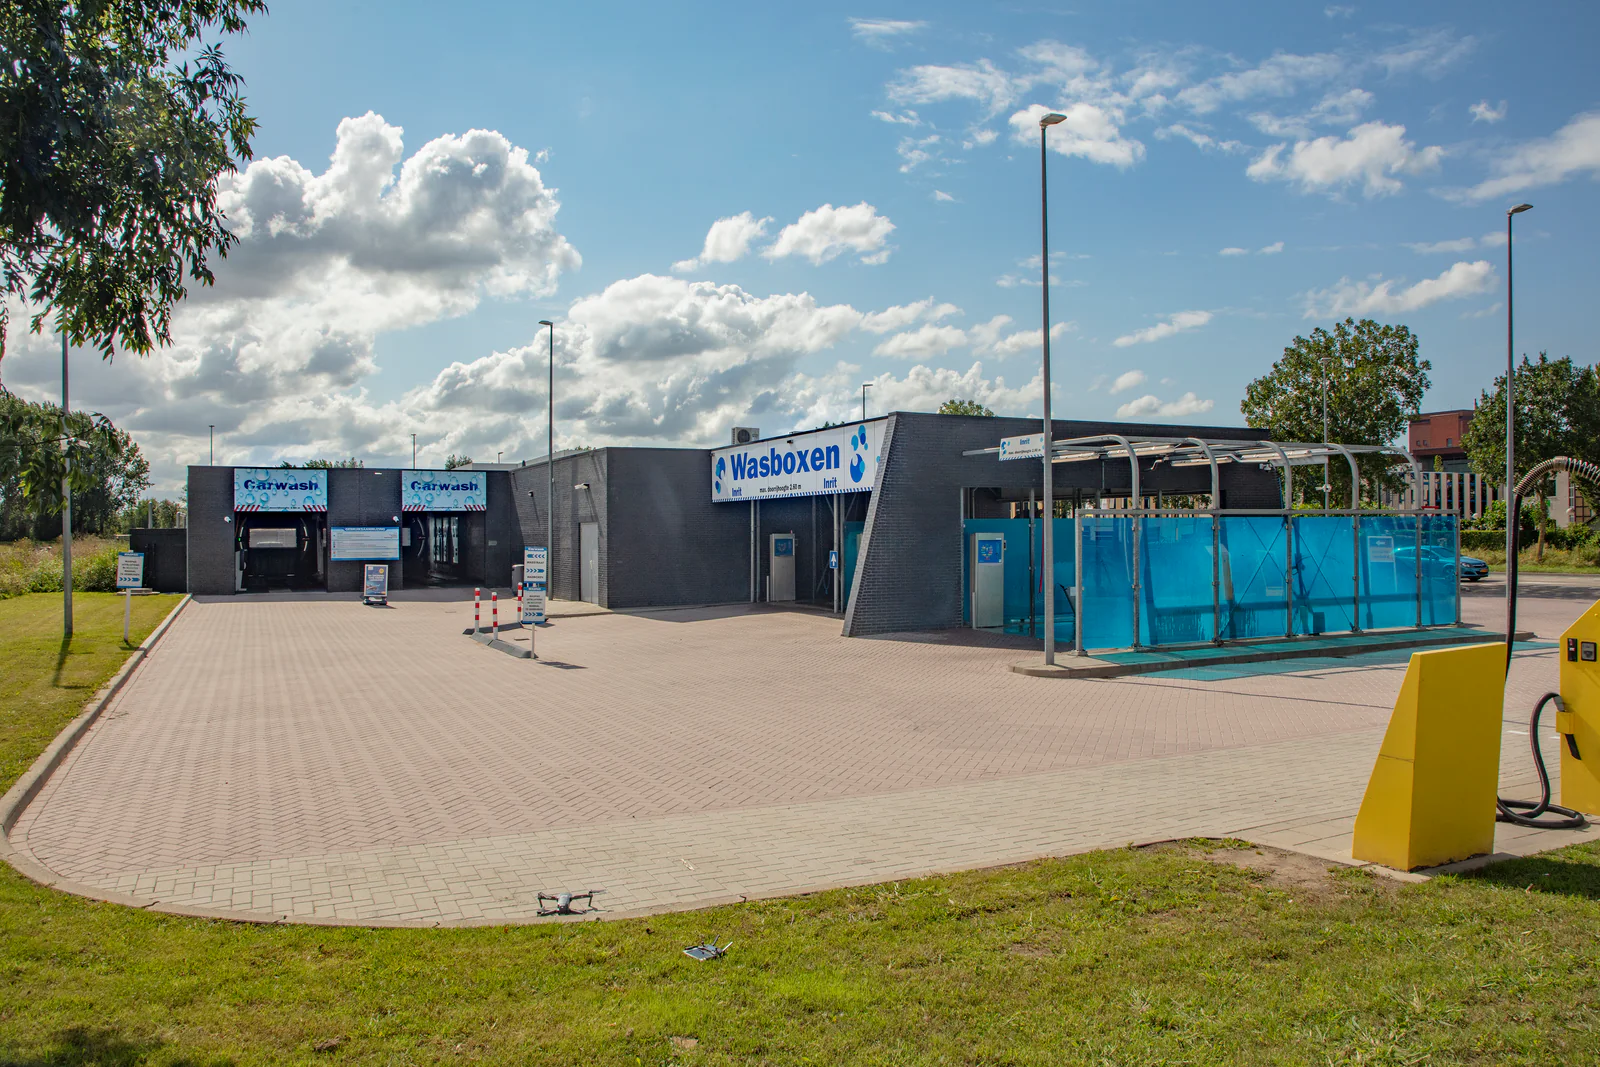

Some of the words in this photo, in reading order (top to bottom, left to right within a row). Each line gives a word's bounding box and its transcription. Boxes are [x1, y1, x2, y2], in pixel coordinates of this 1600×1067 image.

[730, 444, 840, 480] Wasboxen
[243, 479, 319, 491] Carwash
[410, 481, 478, 491] Carwash
[823, 476, 837, 489] Inrit
[731, 486, 742, 497] Inrit
